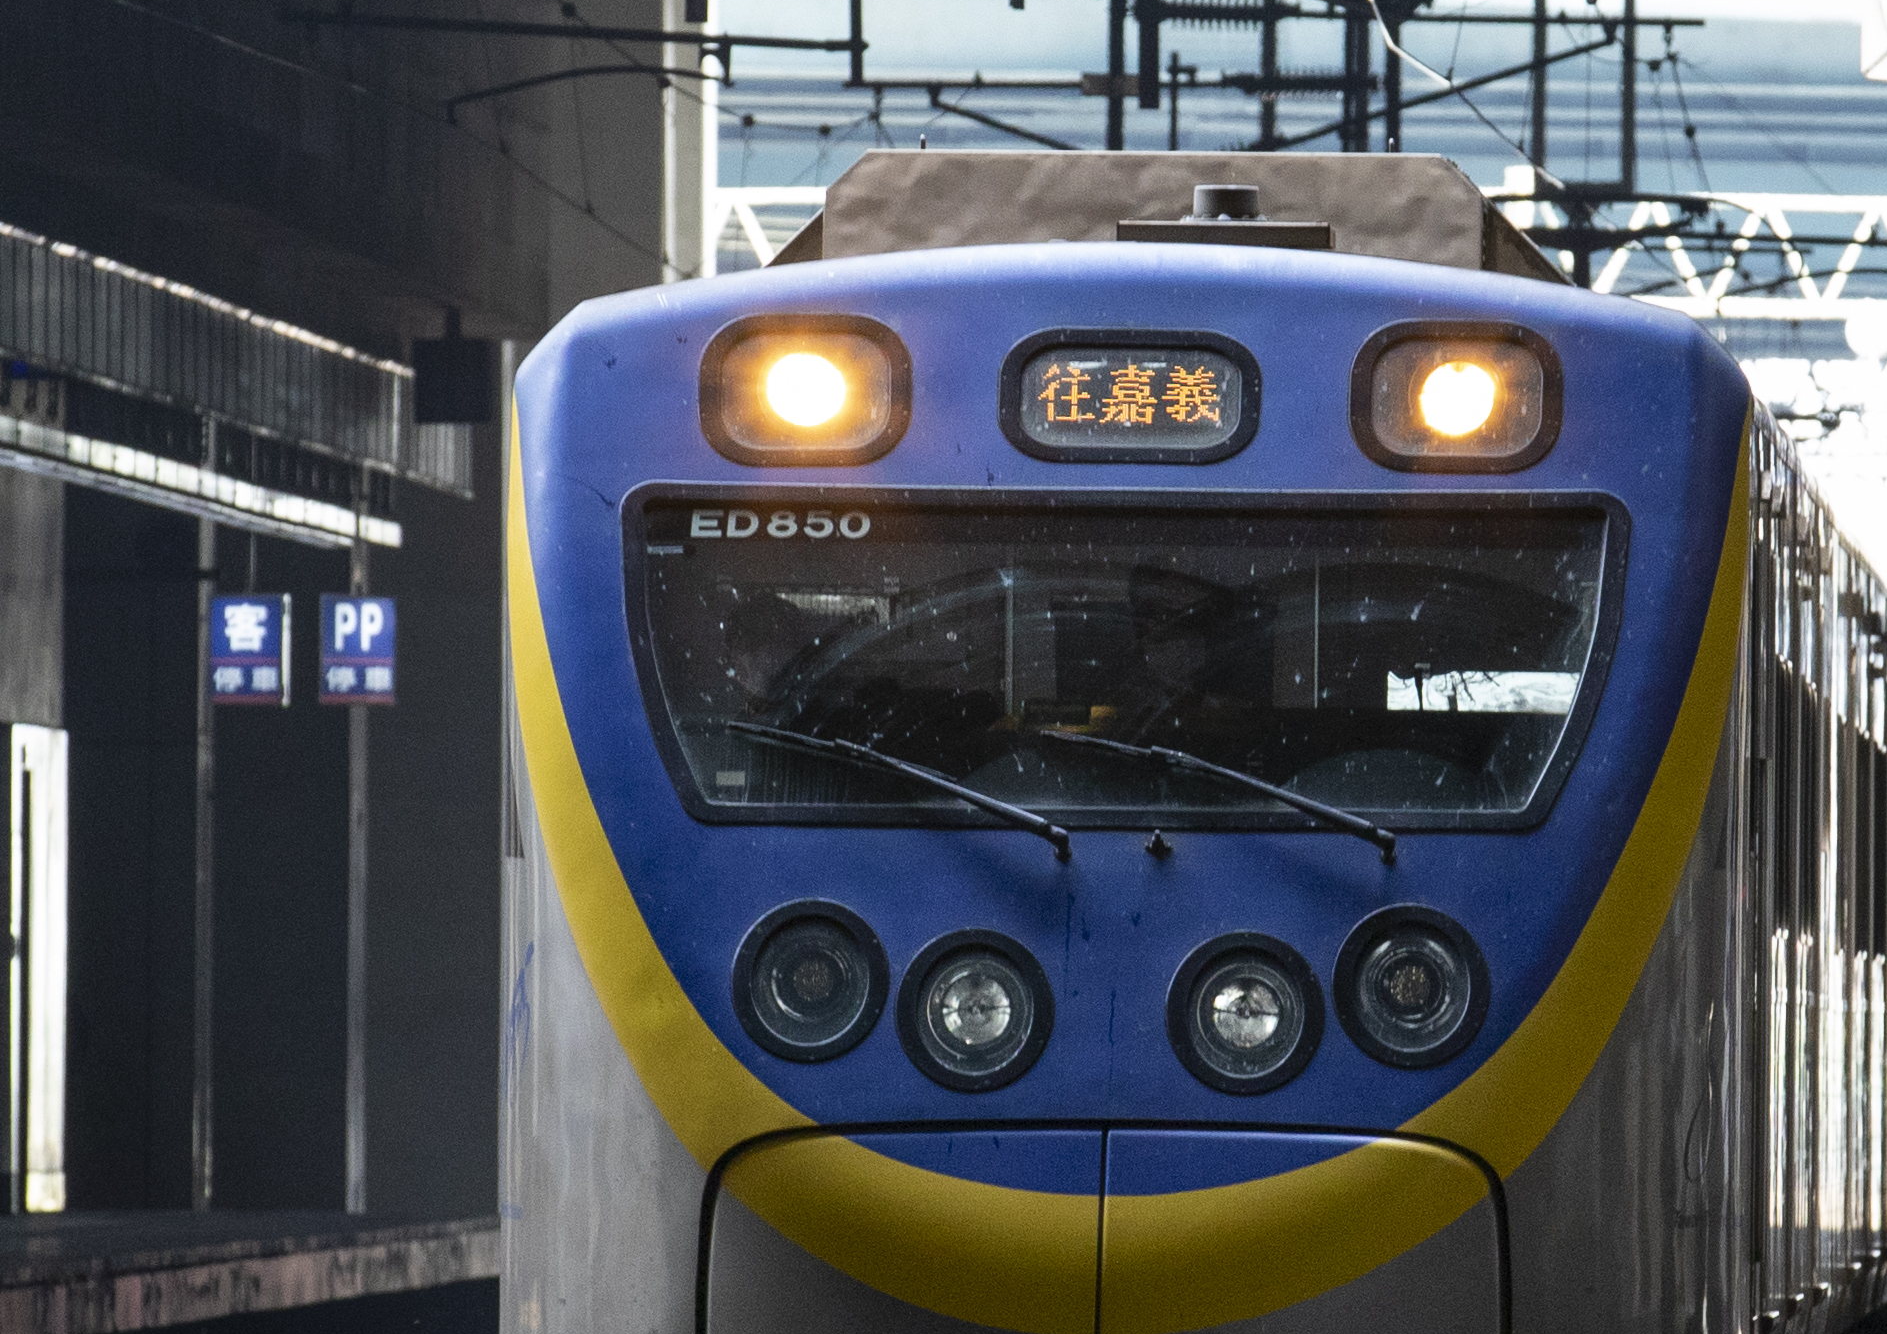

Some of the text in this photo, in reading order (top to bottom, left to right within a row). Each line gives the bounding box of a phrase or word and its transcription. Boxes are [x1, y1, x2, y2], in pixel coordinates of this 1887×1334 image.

[1038, 363, 1220, 424] 往嘉義
[690, 509, 871, 539] ED850
[224, 603, 268, 652] 客
[334, 602, 384, 652] PP
